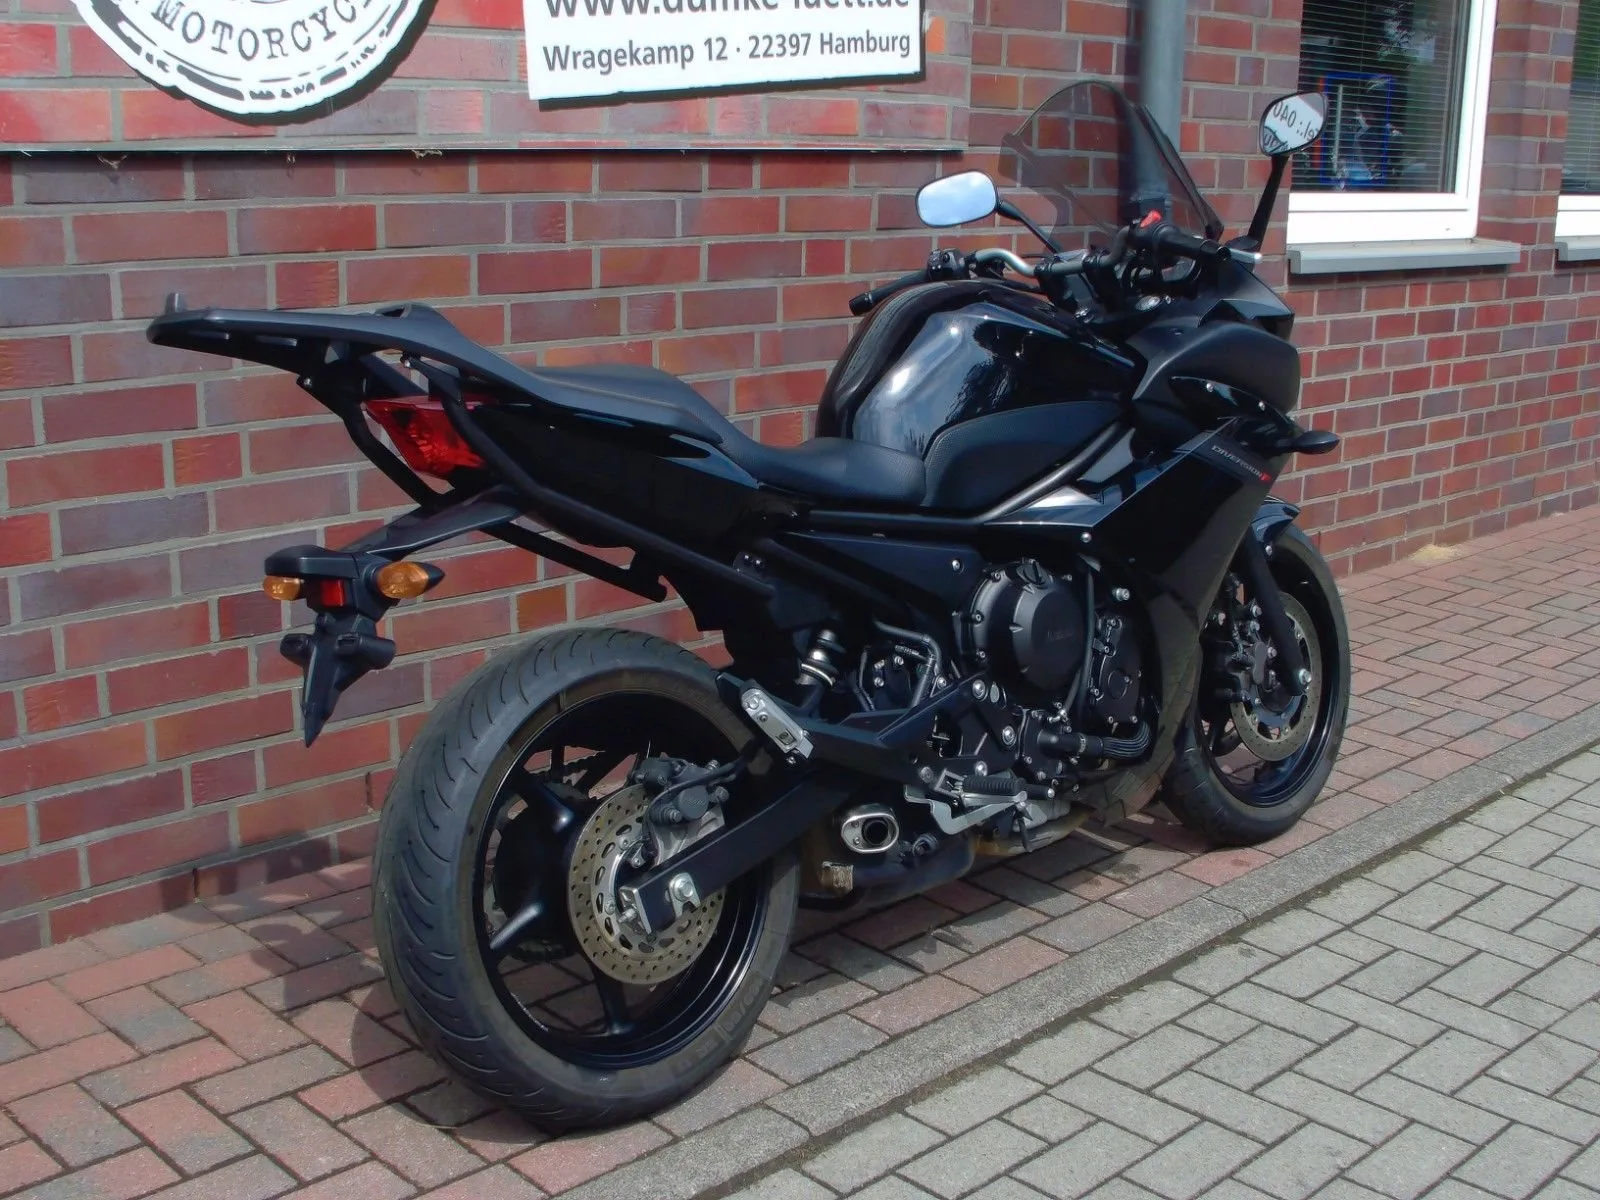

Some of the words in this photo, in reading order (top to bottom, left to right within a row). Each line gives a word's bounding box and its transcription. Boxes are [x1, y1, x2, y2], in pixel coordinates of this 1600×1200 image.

[150, 0, 371, 60] MOTORCYC
[542, 39, 694, 76] Wragekamp
[703, 36, 728, 61] 12
[748, 33, 812, 59] 22397
[819, 29, 910, 58] Hamburg
